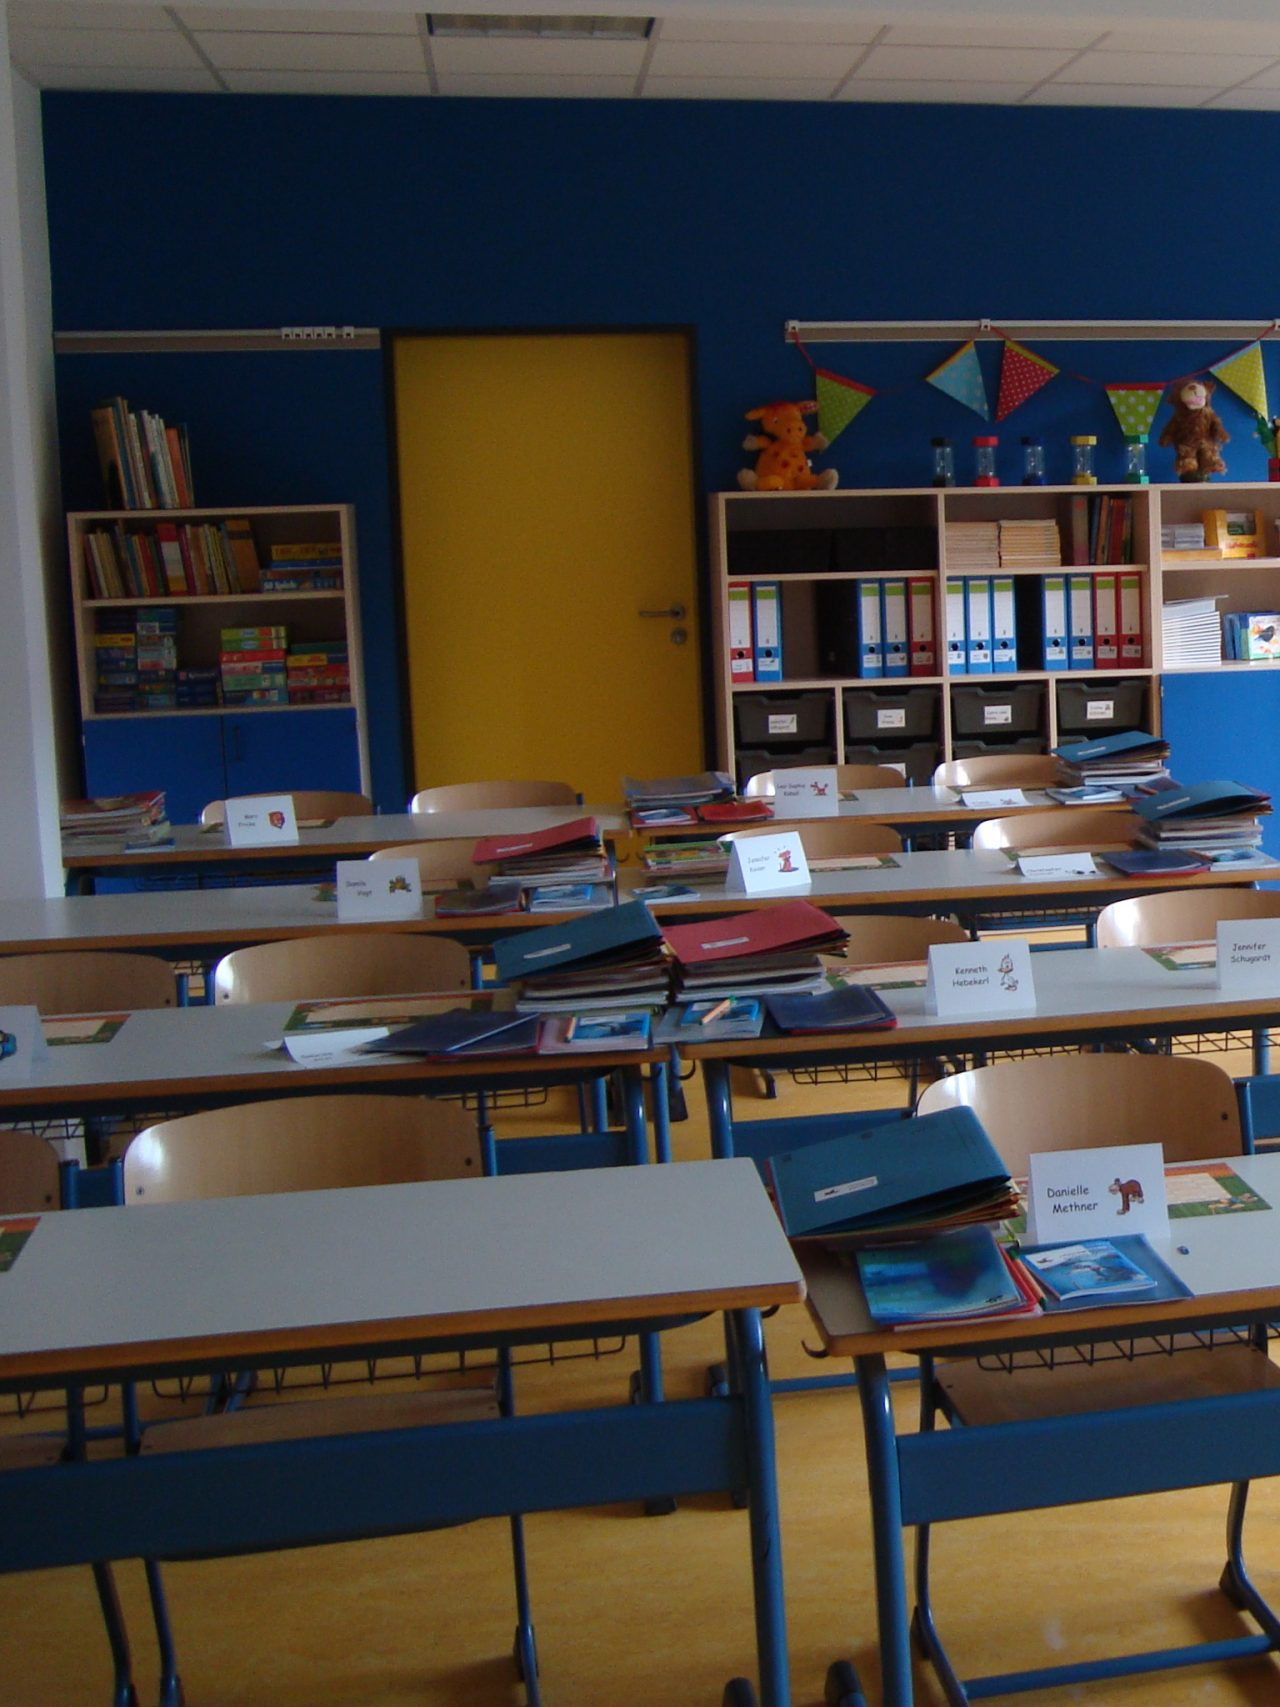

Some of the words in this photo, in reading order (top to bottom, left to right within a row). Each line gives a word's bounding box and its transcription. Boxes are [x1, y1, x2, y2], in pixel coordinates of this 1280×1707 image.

[1232, 942, 1267, 952] Jennifer
[955, 963, 989, 975] Kenneth
[1047, 1185, 1090, 1198] Danielle
[1052, 1202, 1098, 1214] Methner
